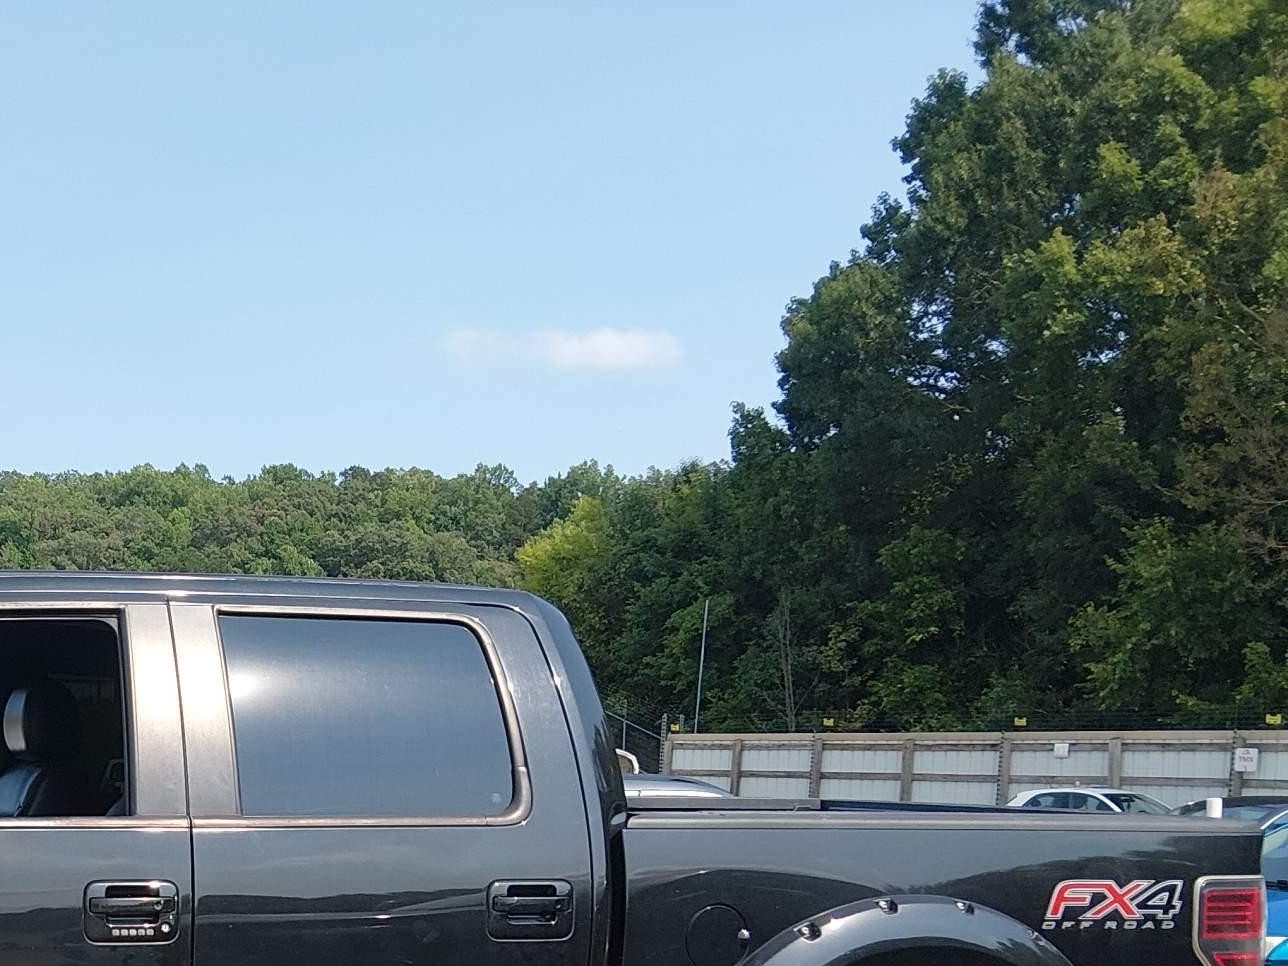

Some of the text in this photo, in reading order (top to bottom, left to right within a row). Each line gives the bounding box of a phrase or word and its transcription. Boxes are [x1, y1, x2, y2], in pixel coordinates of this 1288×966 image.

[1043, 879, 1184, 920] FX4
[1041, 920, 1175, 930] OFF ROAD
